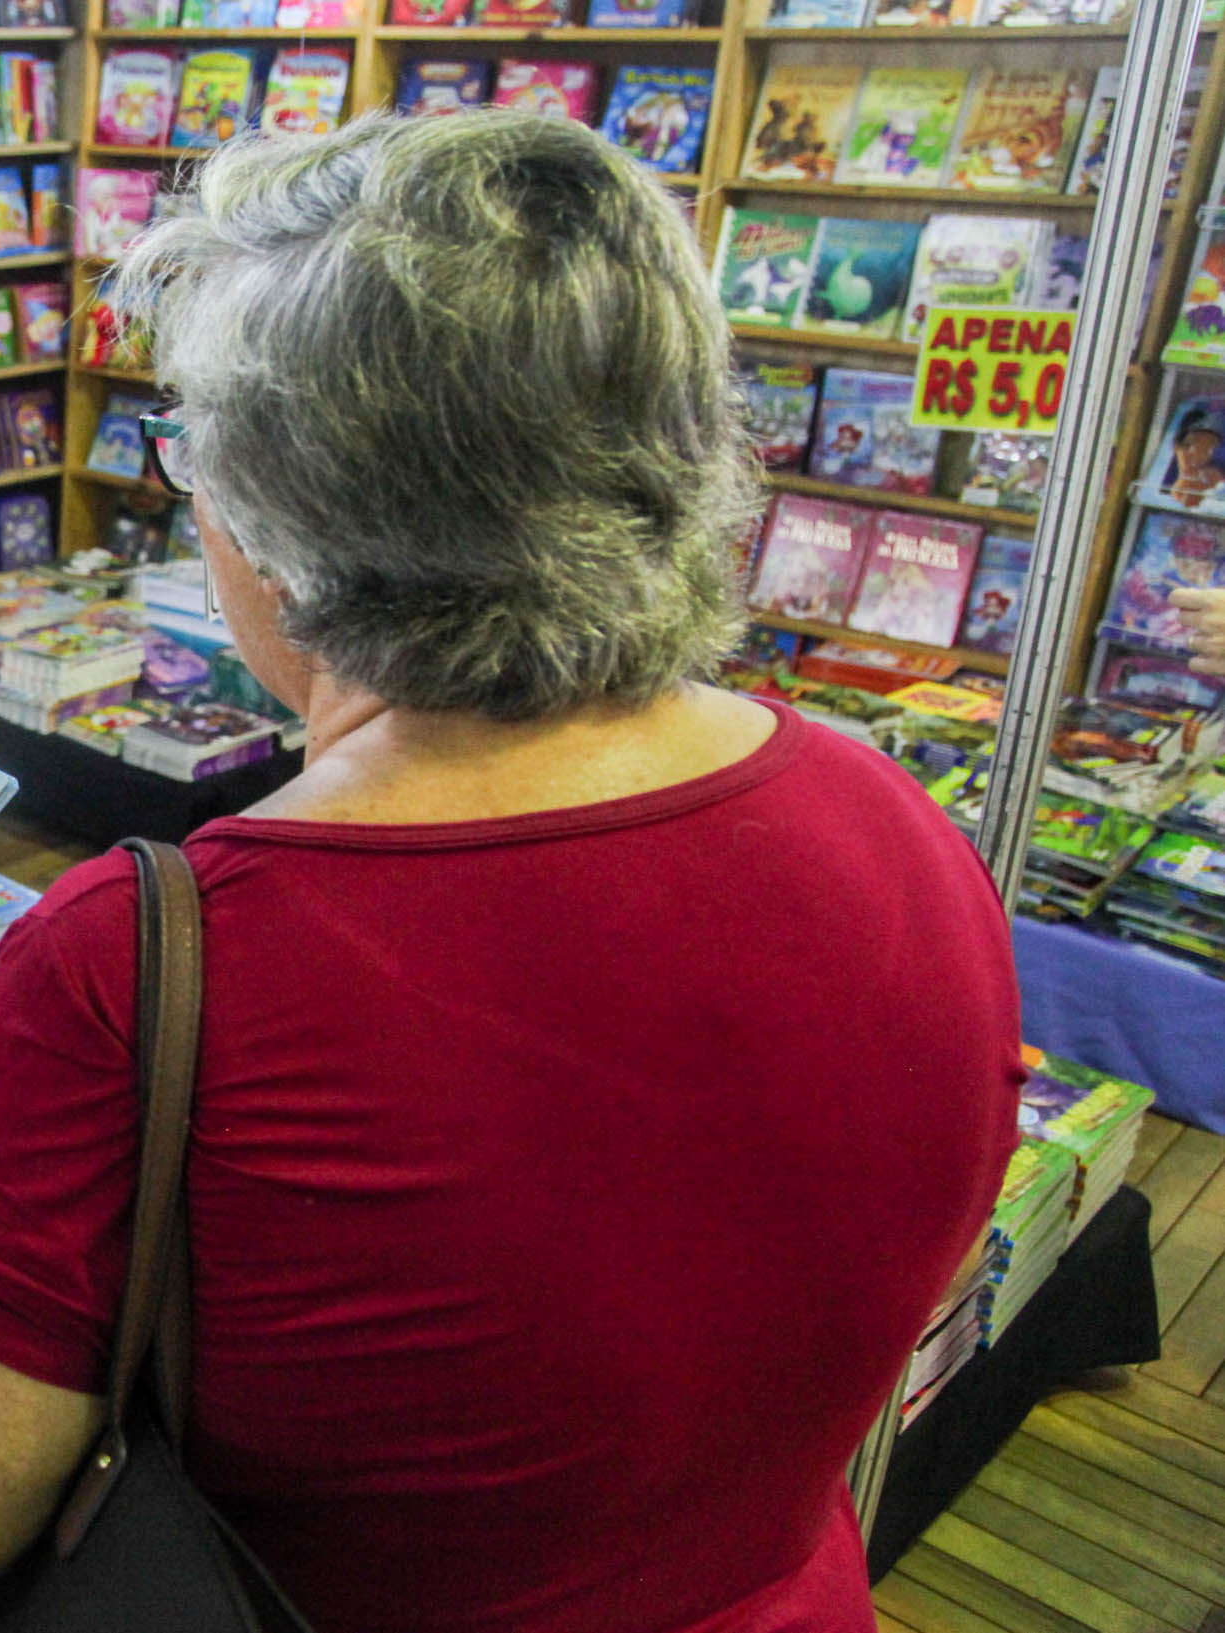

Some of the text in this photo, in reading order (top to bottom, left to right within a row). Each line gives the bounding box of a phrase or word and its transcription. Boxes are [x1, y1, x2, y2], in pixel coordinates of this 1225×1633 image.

[930, 317, 1072, 355] APENA
[923, 358, 1065, 427] R$ 5,0
